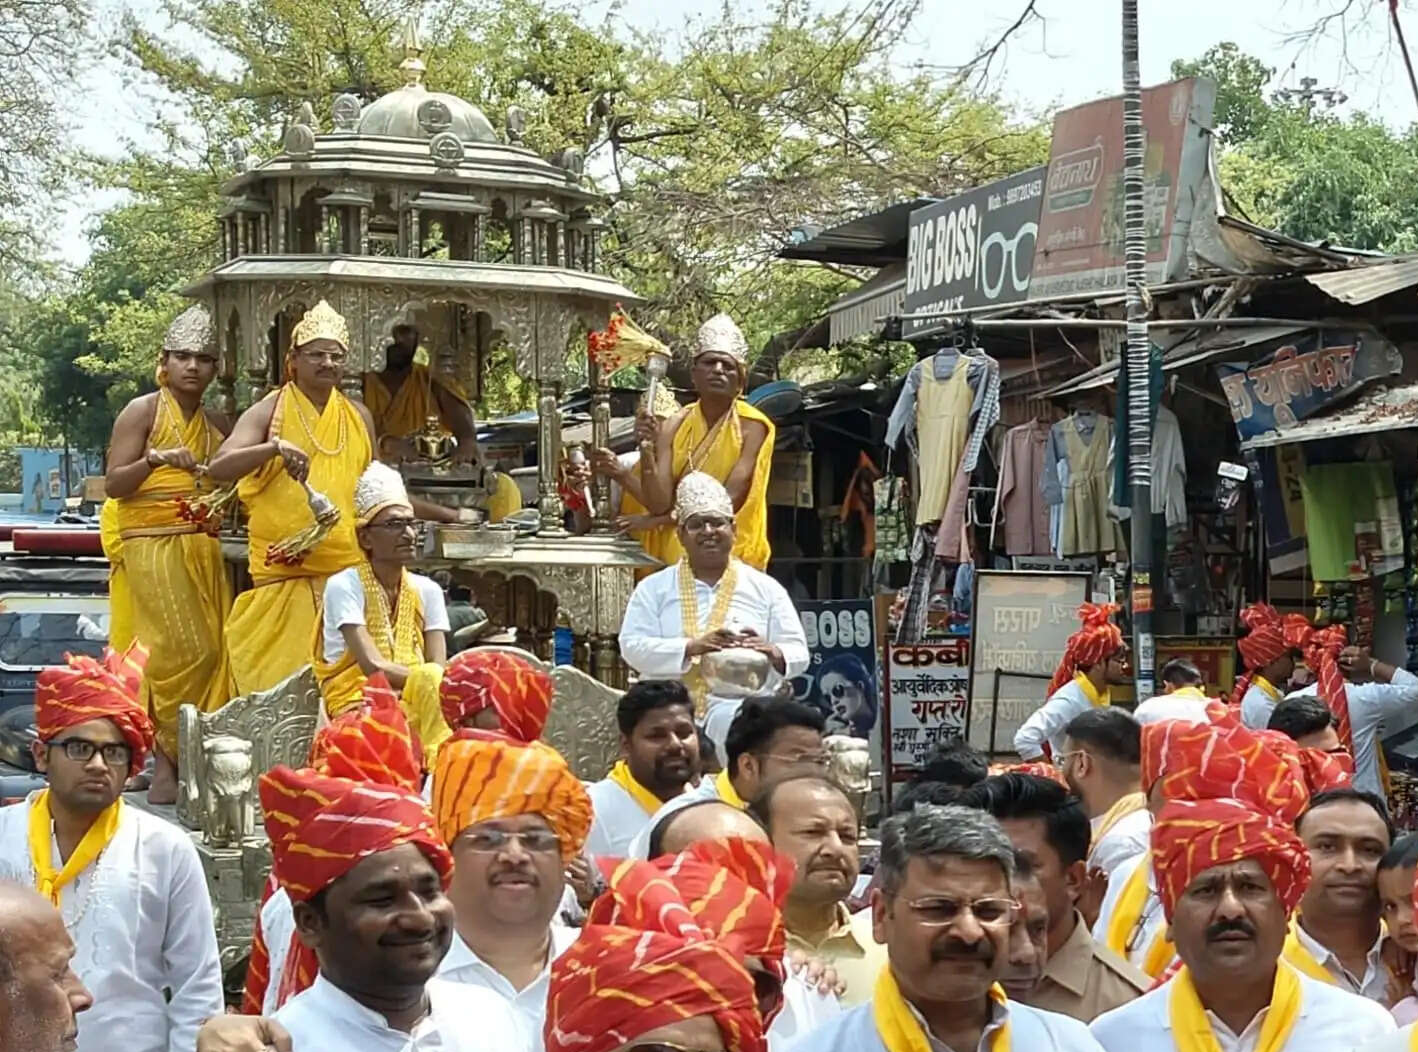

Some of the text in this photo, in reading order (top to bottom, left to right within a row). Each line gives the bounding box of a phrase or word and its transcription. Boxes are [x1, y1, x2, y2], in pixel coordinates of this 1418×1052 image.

[907, 203, 978, 295] BIG BOSS
[800, 609, 872, 648] BOSS
